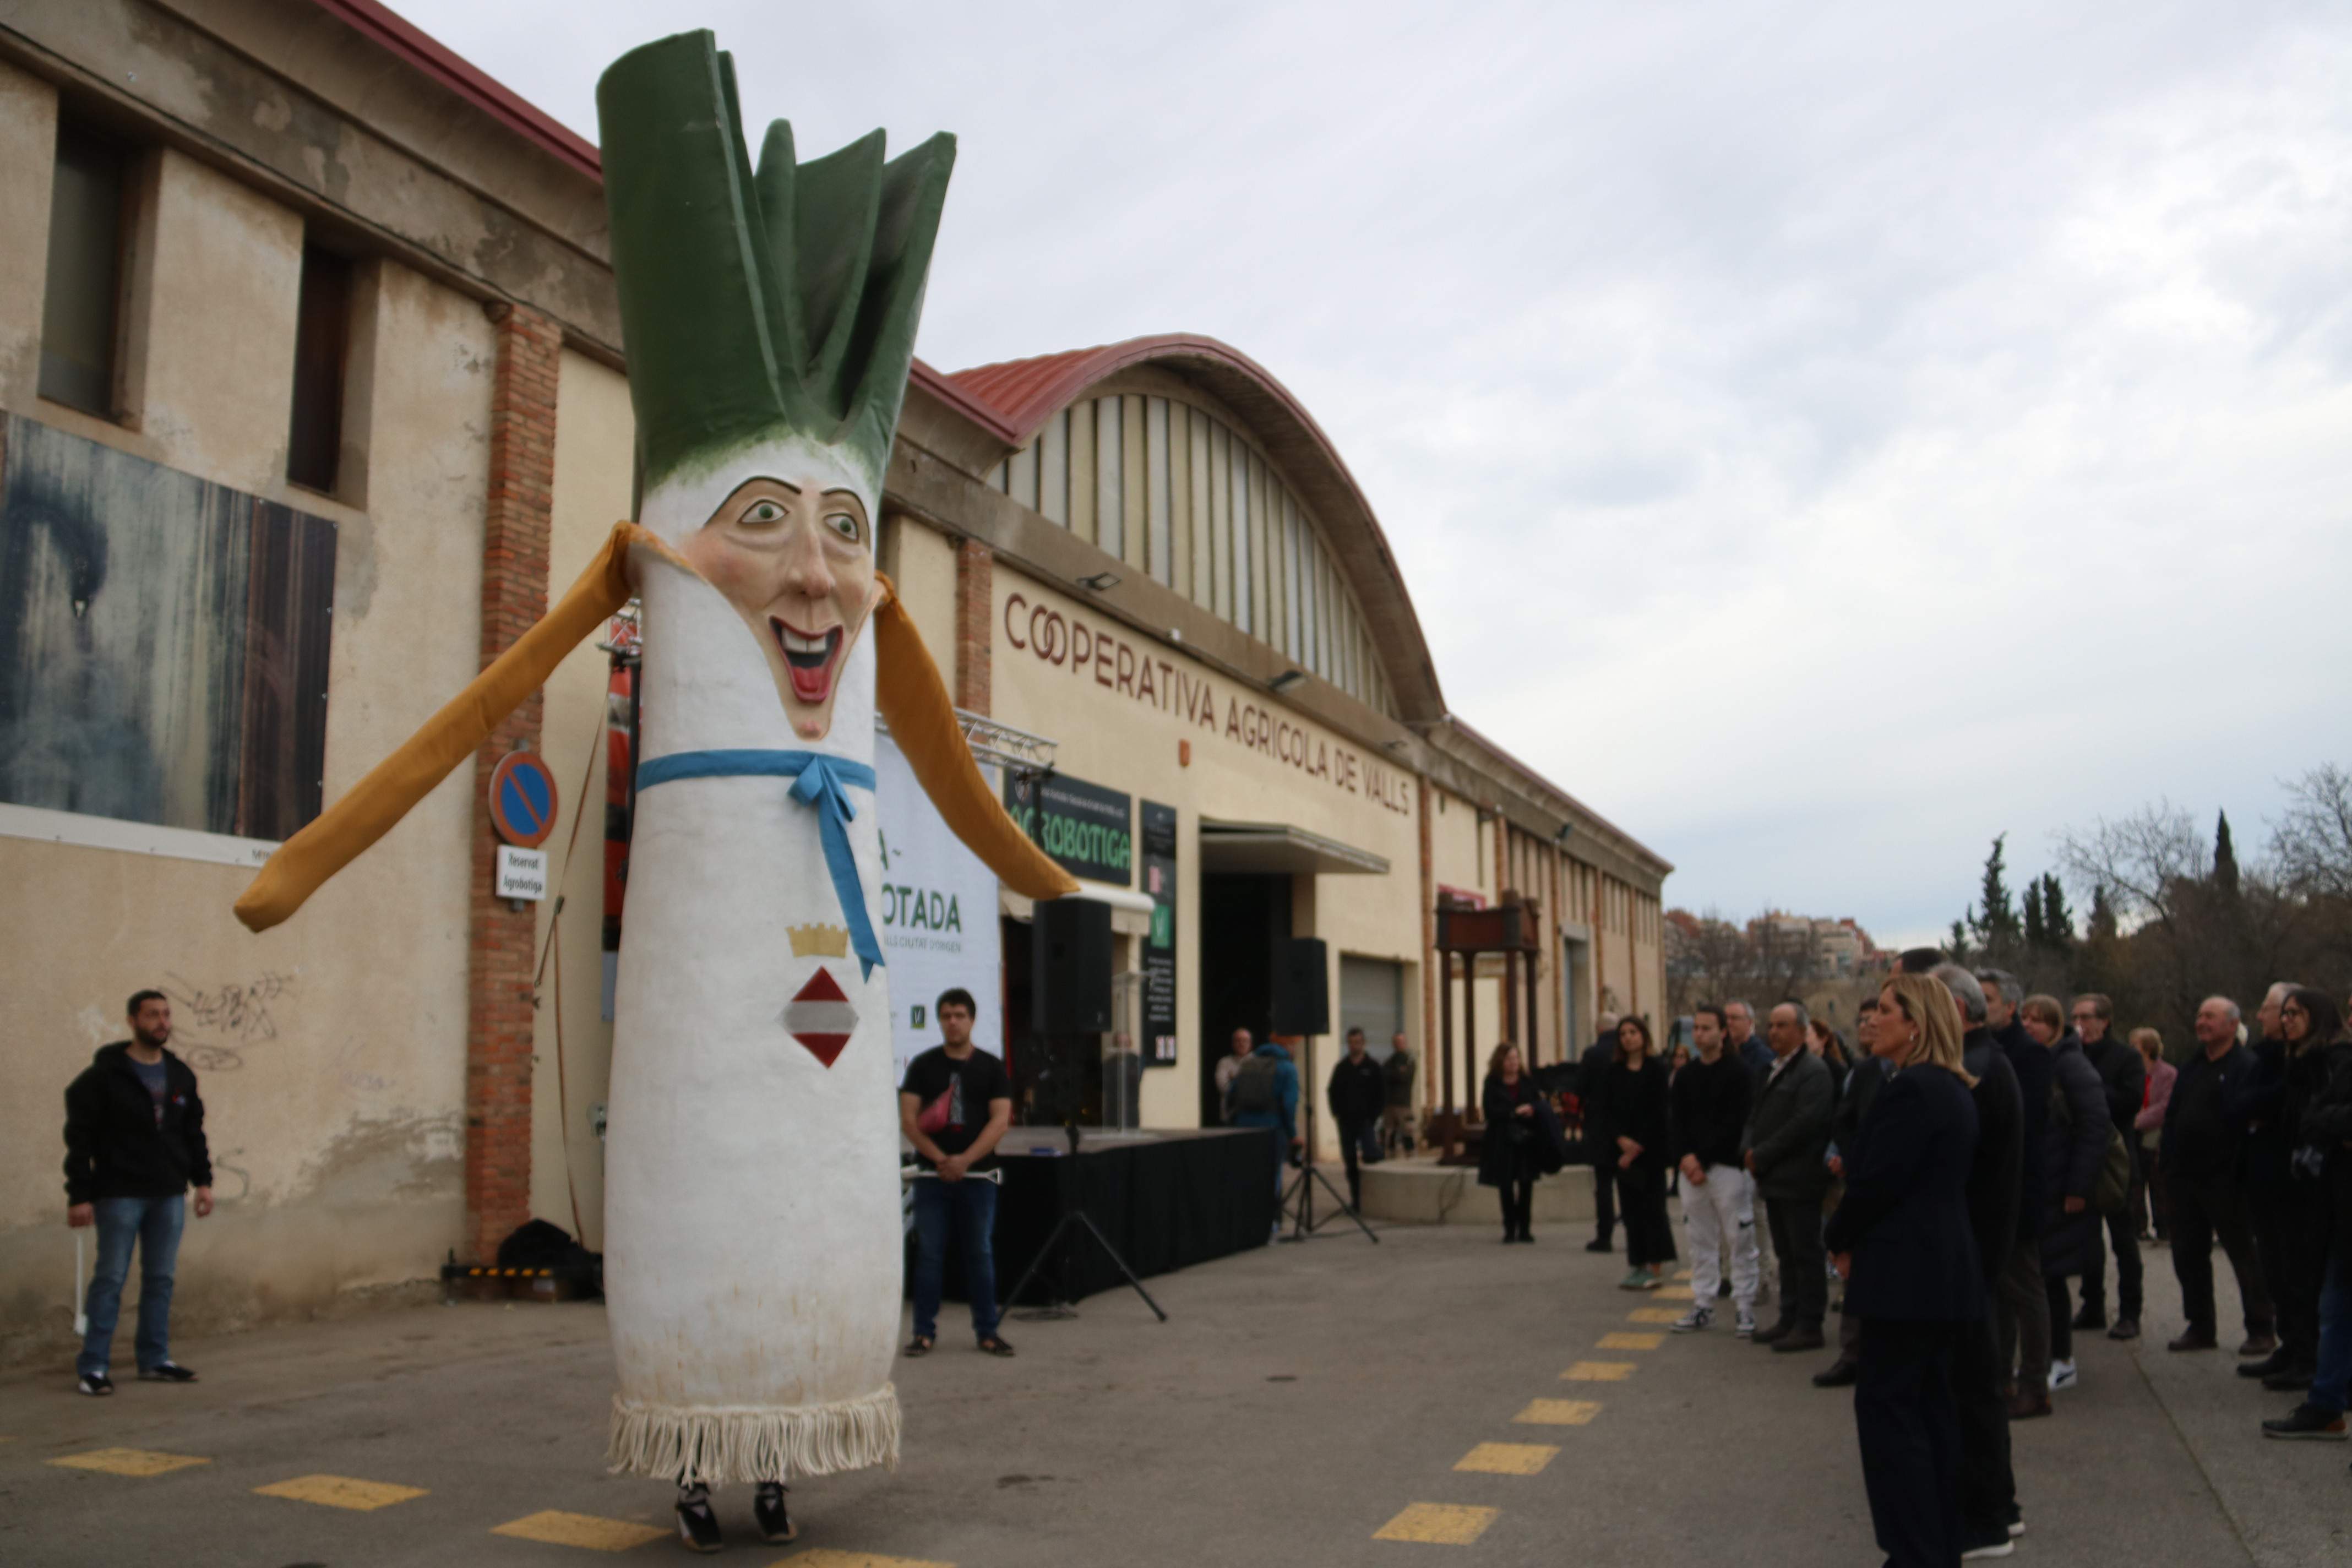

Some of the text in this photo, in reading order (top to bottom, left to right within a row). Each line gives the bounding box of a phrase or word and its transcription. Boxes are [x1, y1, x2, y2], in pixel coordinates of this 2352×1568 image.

[1004, 591, 1408, 816] COOPERATIVA AGRICOLA DE VALLS
[508, 853, 538, 869] Reservat
[503, 874, 542, 894] Agrobotiga
